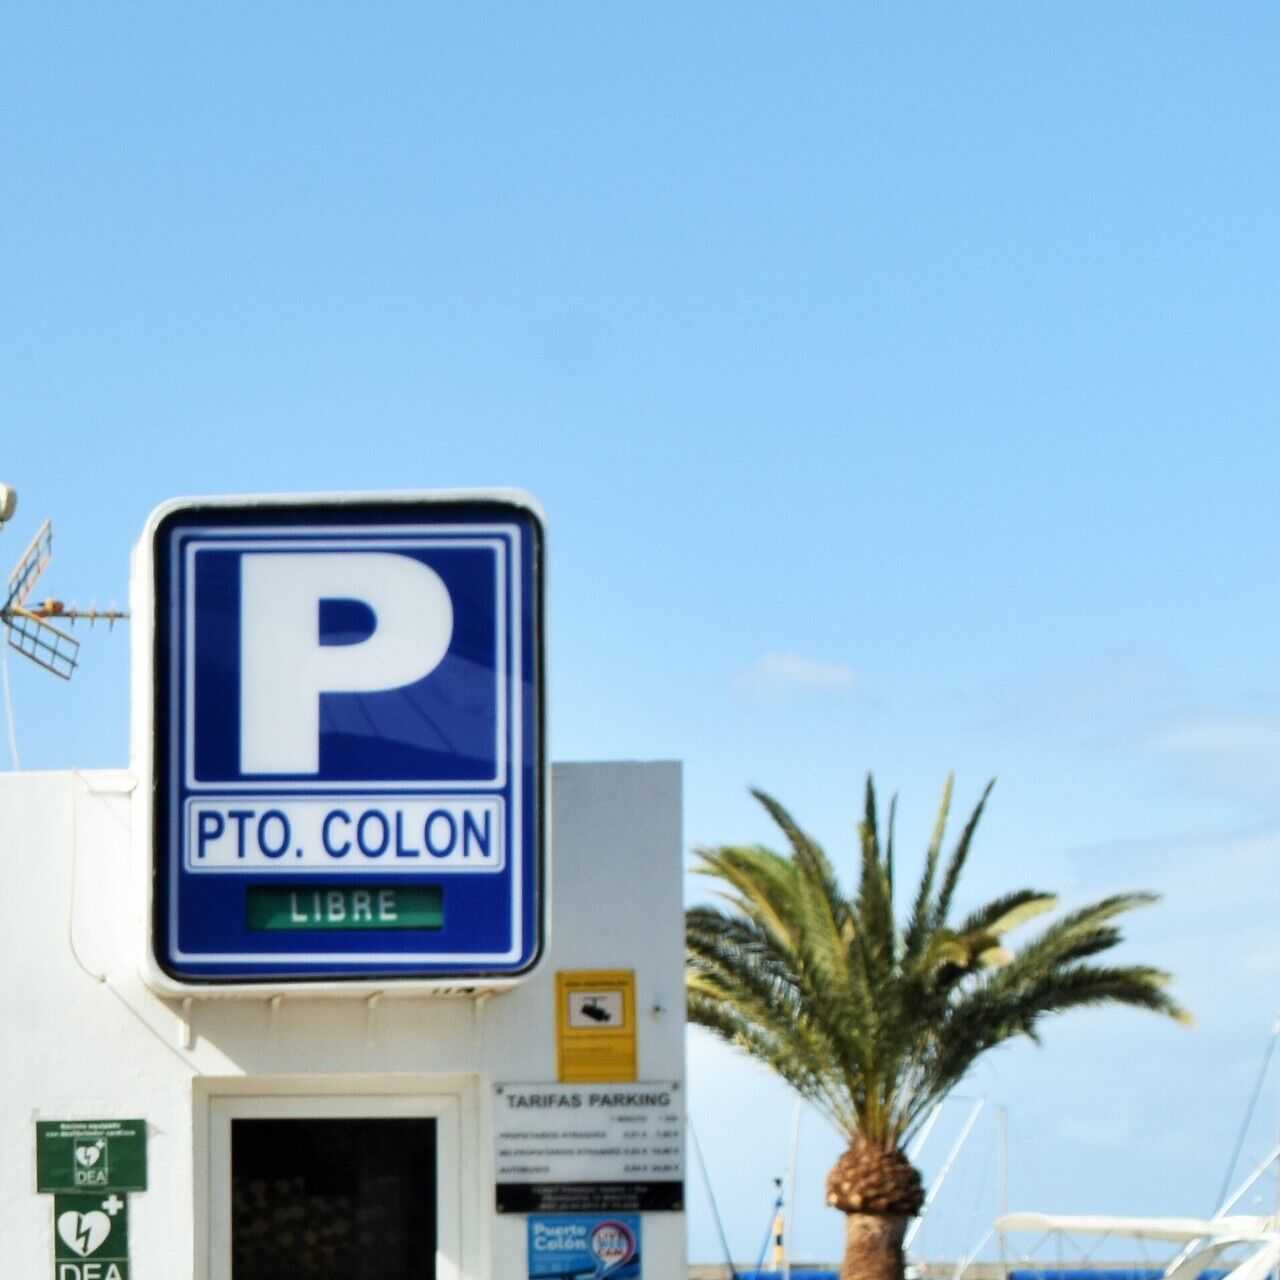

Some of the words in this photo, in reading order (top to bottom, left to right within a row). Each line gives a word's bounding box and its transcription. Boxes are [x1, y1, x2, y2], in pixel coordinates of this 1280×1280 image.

[240, 552, 454, 775] P
[197, 809, 303, 859] PTO.
[321, 808, 491, 859] COLON
[291, 890, 398, 922] LIBRE
[506, 1093, 582, 1109] TARIFAS
[588, 1091, 671, 1108] PARKING
[77, 1170, 107, 1185] DEA
[534, 1222, 587, 1236] Puerto
[534, 1234, 587, 1251] Colón
